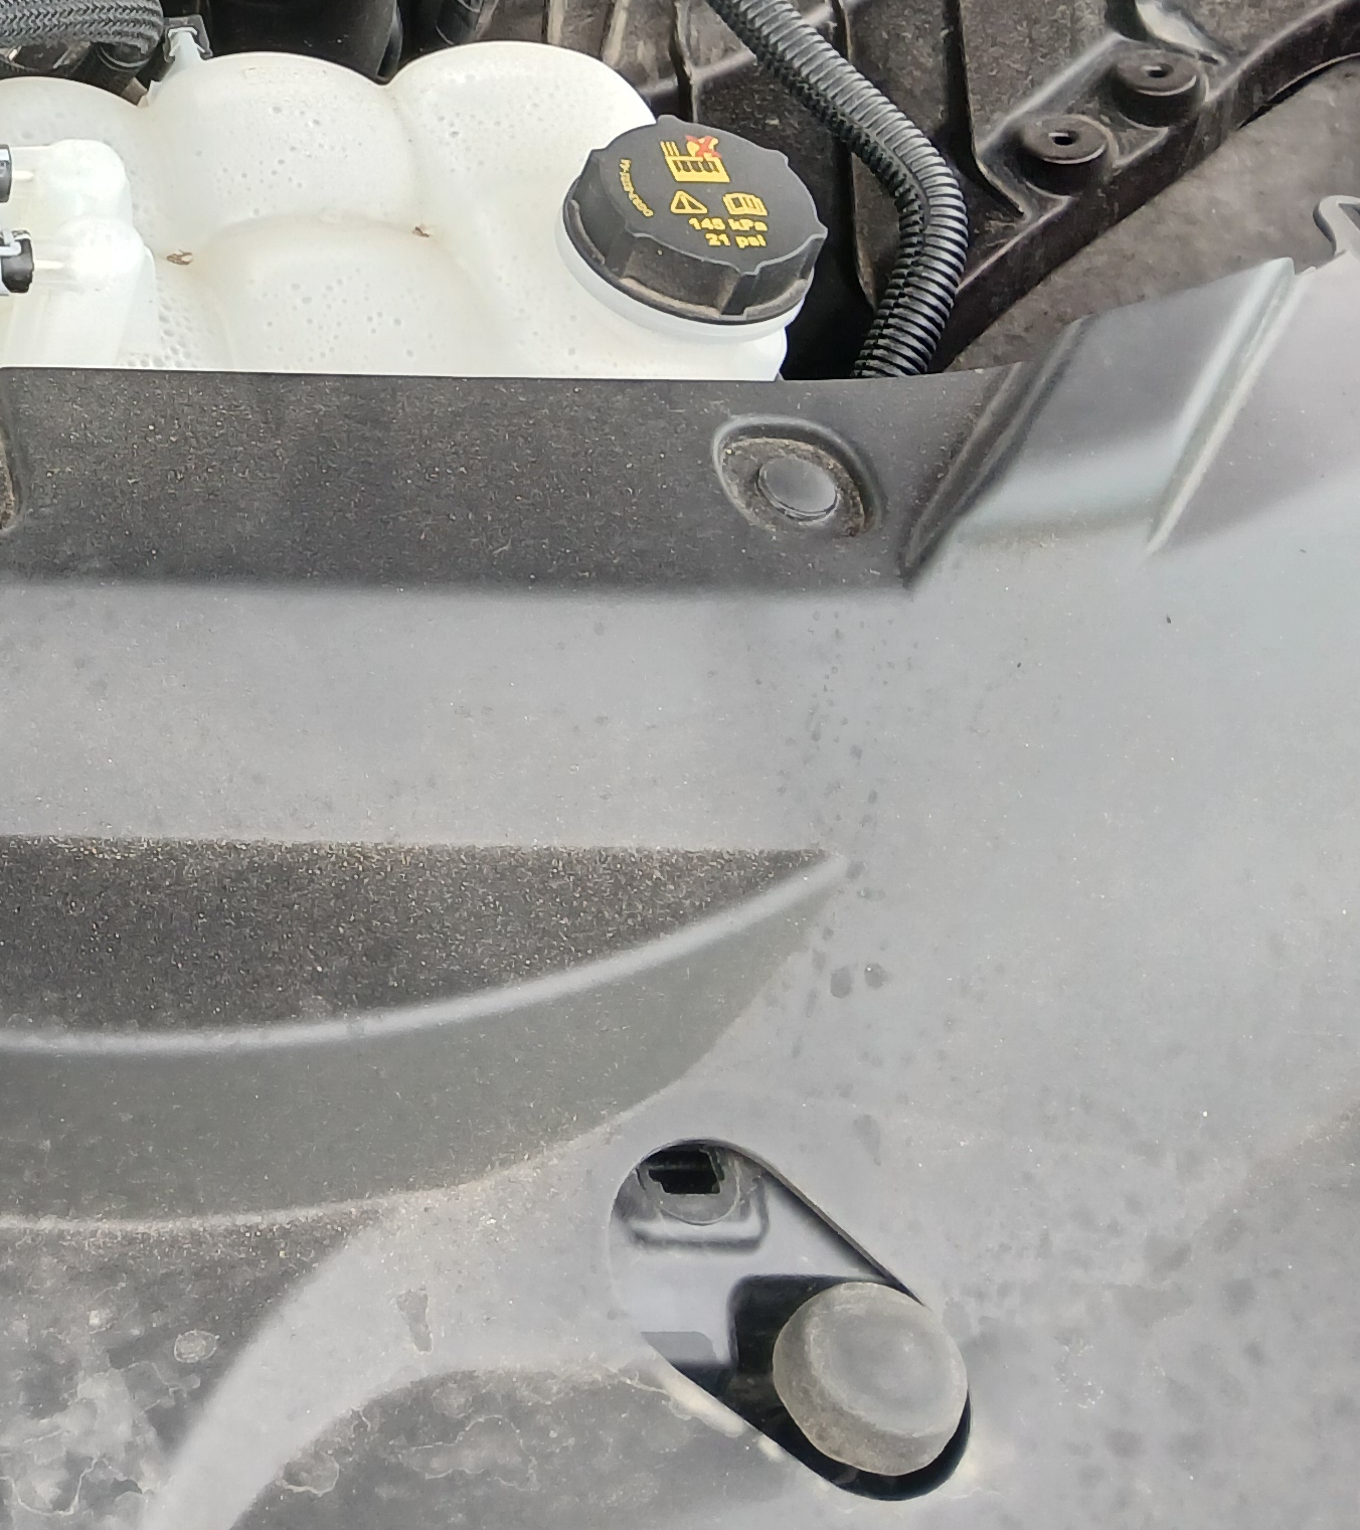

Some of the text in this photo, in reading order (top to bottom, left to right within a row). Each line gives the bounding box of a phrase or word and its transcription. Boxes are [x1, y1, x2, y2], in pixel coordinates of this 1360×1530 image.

[728, 218, 768, 232] kPa
[705, 233, 766, 249] 21 psi
